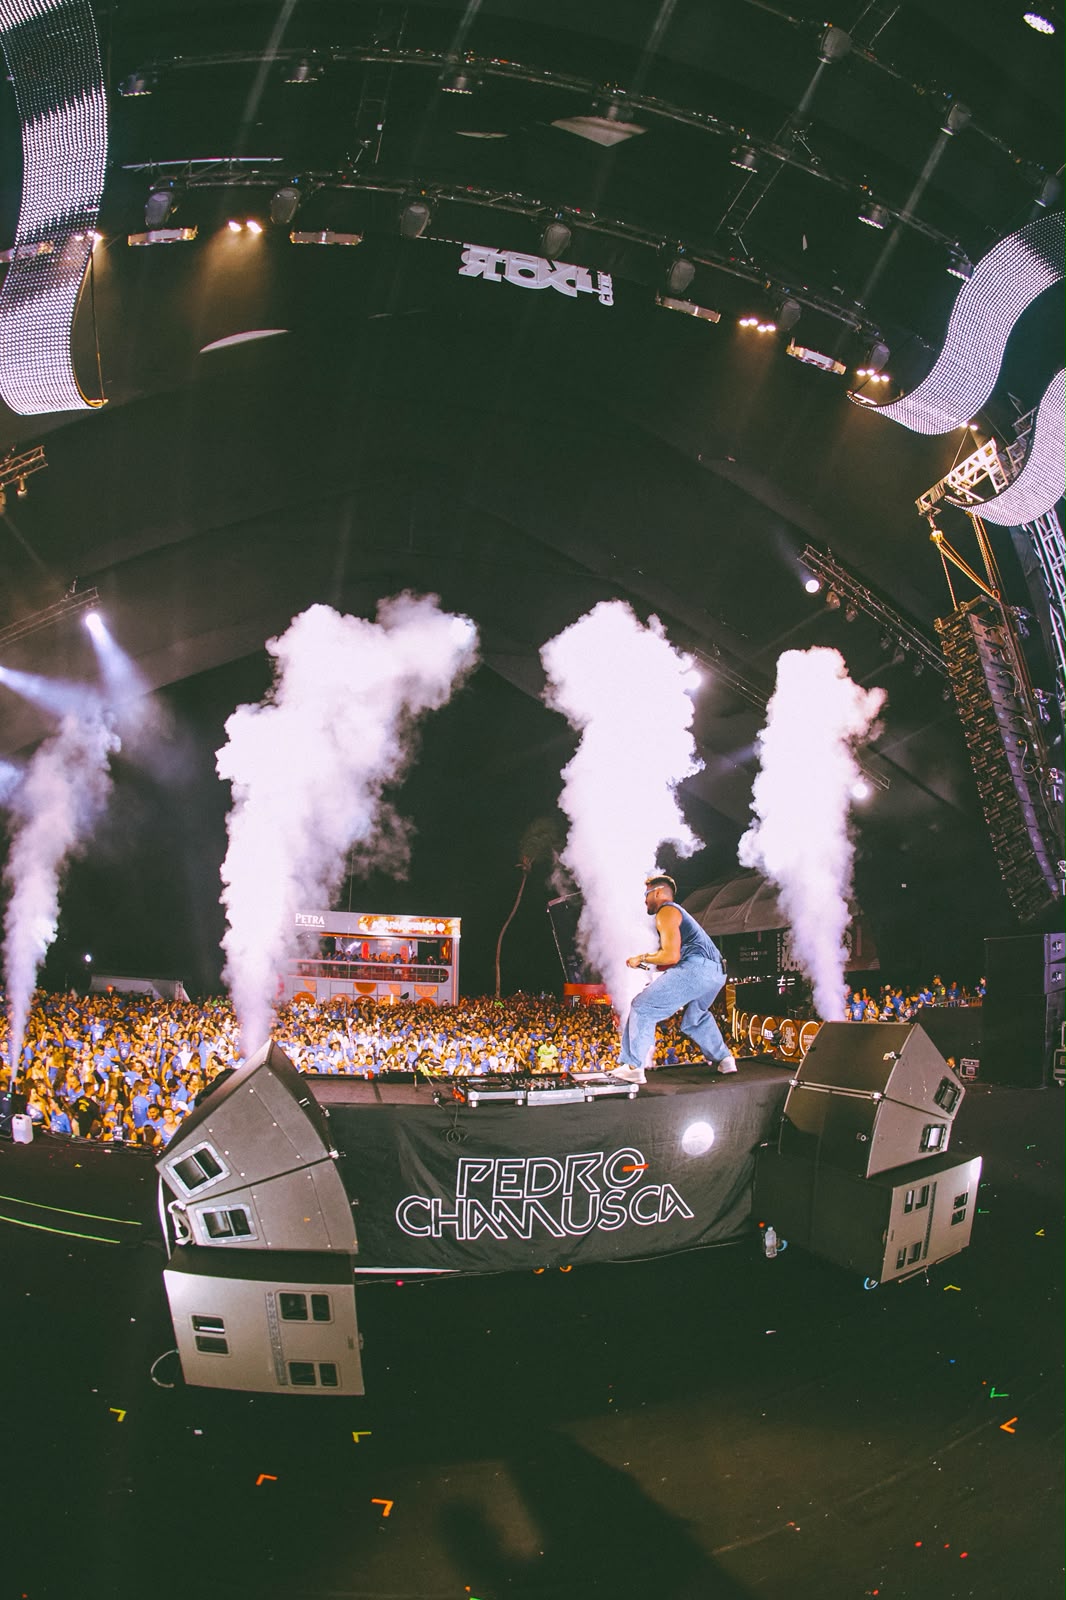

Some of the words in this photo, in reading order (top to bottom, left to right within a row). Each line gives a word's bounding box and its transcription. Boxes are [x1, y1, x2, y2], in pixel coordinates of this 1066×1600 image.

[295, 912, 325, 925] PETRA
[456, 1148, 649, 1199] PEDRO
[395, 1184, 695, 1240] CHAMUSCA
